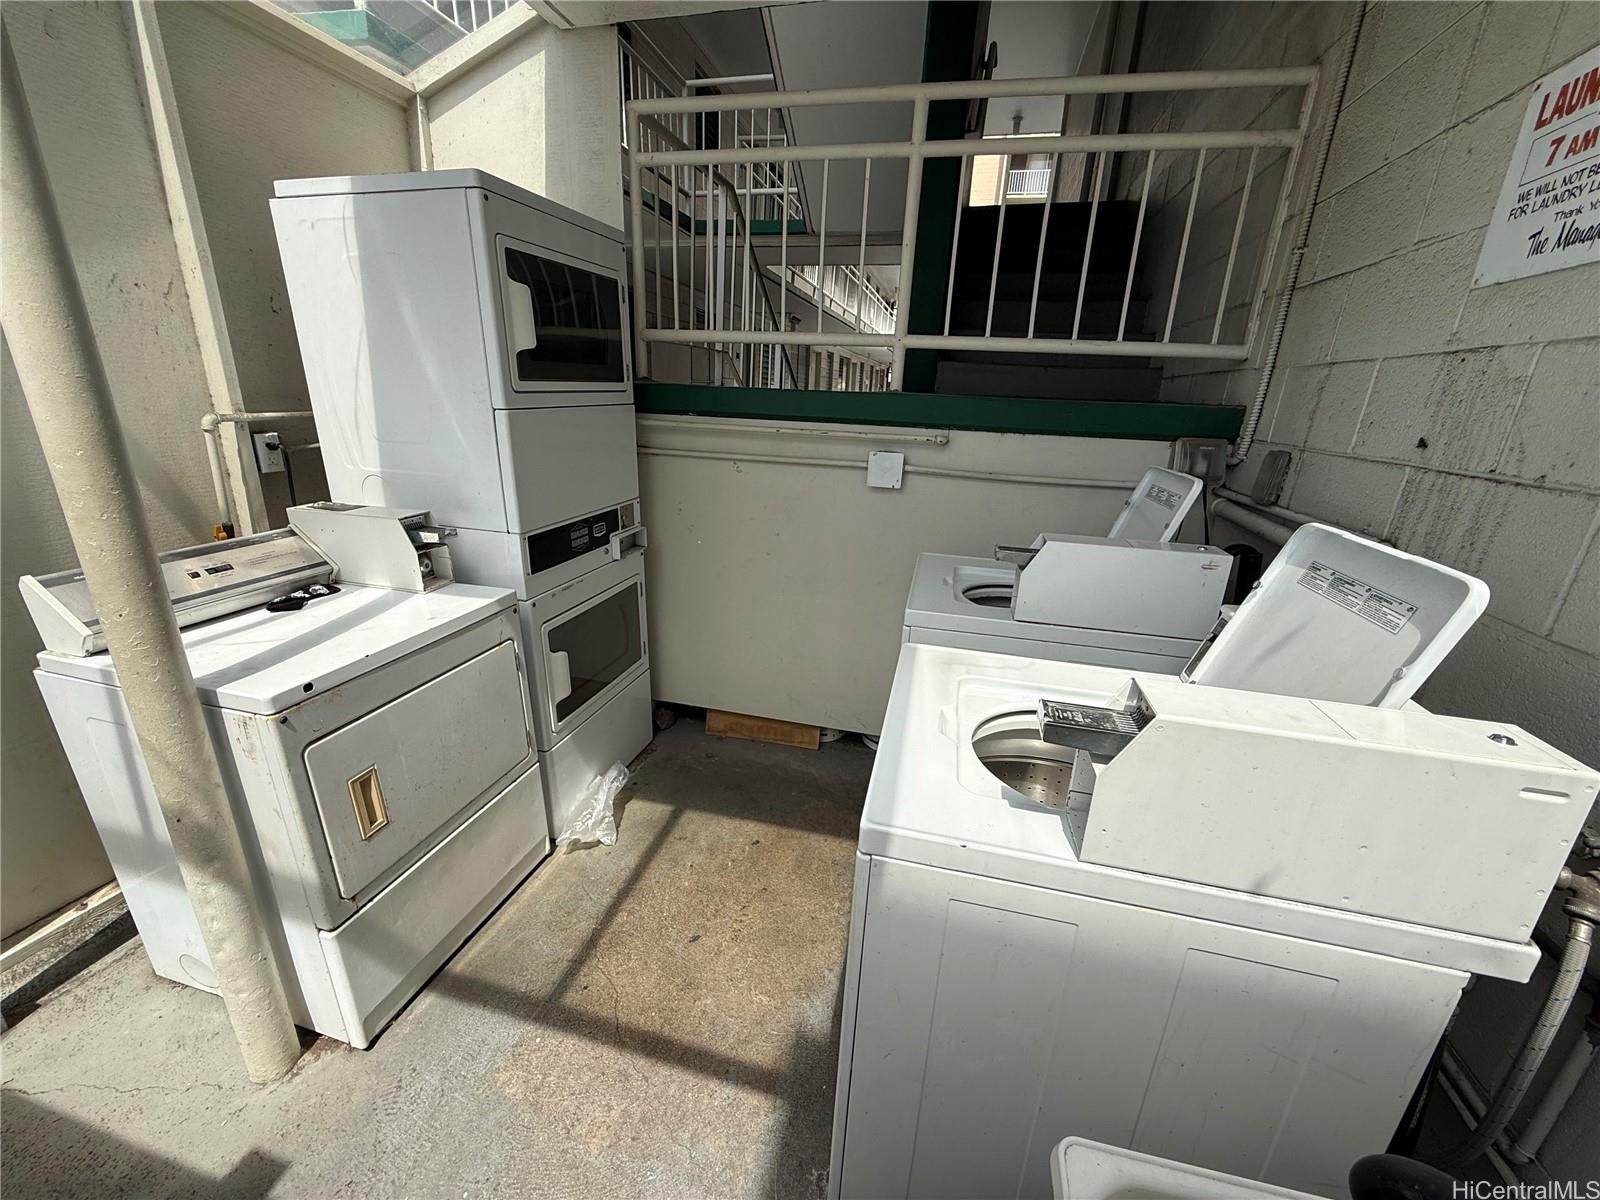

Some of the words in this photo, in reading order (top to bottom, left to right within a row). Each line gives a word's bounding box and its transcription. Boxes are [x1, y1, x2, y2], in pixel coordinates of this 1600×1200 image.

[1534, 66, 1600, 131] LAUN
[1545, 134, 1567, 168] 7
[1563, 125, 1600, 160] AM
[1507, 203, 1530, 223] FOR
[1531, 182, 1589, 214] LAUNDRY
[1517, 188, 1534, 204] WE
[1534, 179, 1558, 198] WILL
[1560, 167, 1589, 189] NOT
[1554, 204, 1585, 223] Thank
[1526, 226, 1550, 259] The
[1550, 219, 1600, 252] Manag
